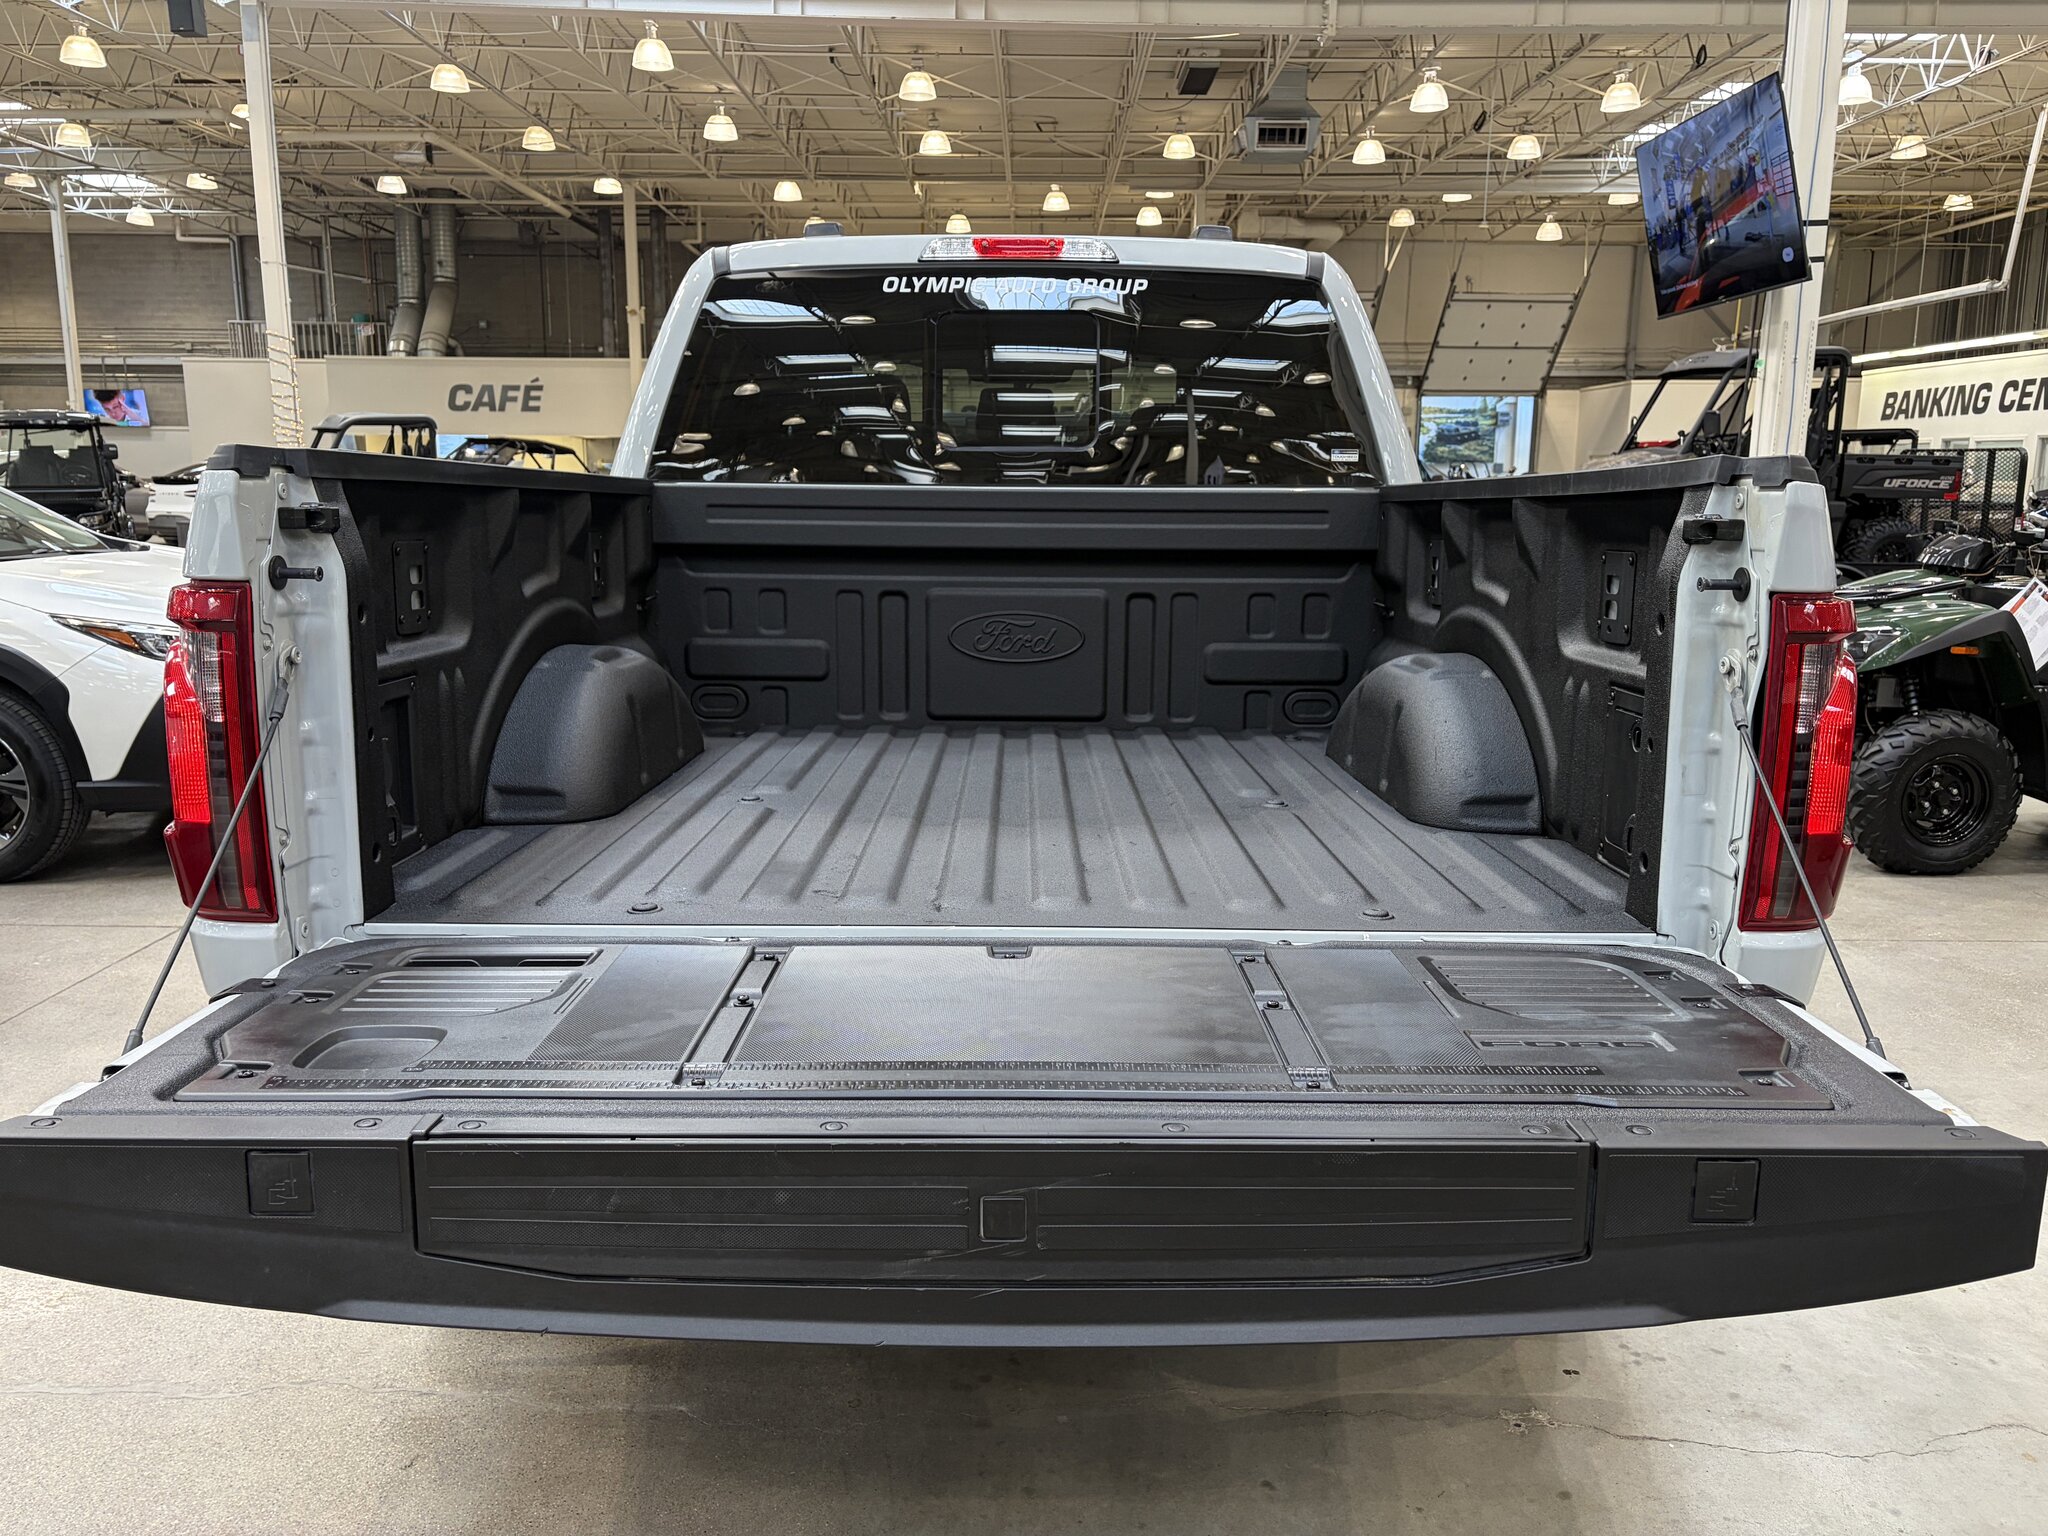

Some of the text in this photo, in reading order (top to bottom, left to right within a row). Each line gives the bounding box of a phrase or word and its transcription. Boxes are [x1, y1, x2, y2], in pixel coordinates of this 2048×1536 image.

[882, 276, 1149, 295] OLYMPIC AUTO GROUP
[447, 376, 544, 412] CAFÉ
[1880, 382, 1993, 421] BANKING
[1883, 478, 1953, 489] UFORCE
[974, 618, 1058, 654] Ford
[1479, 1040, 1660, 1048] FORD
